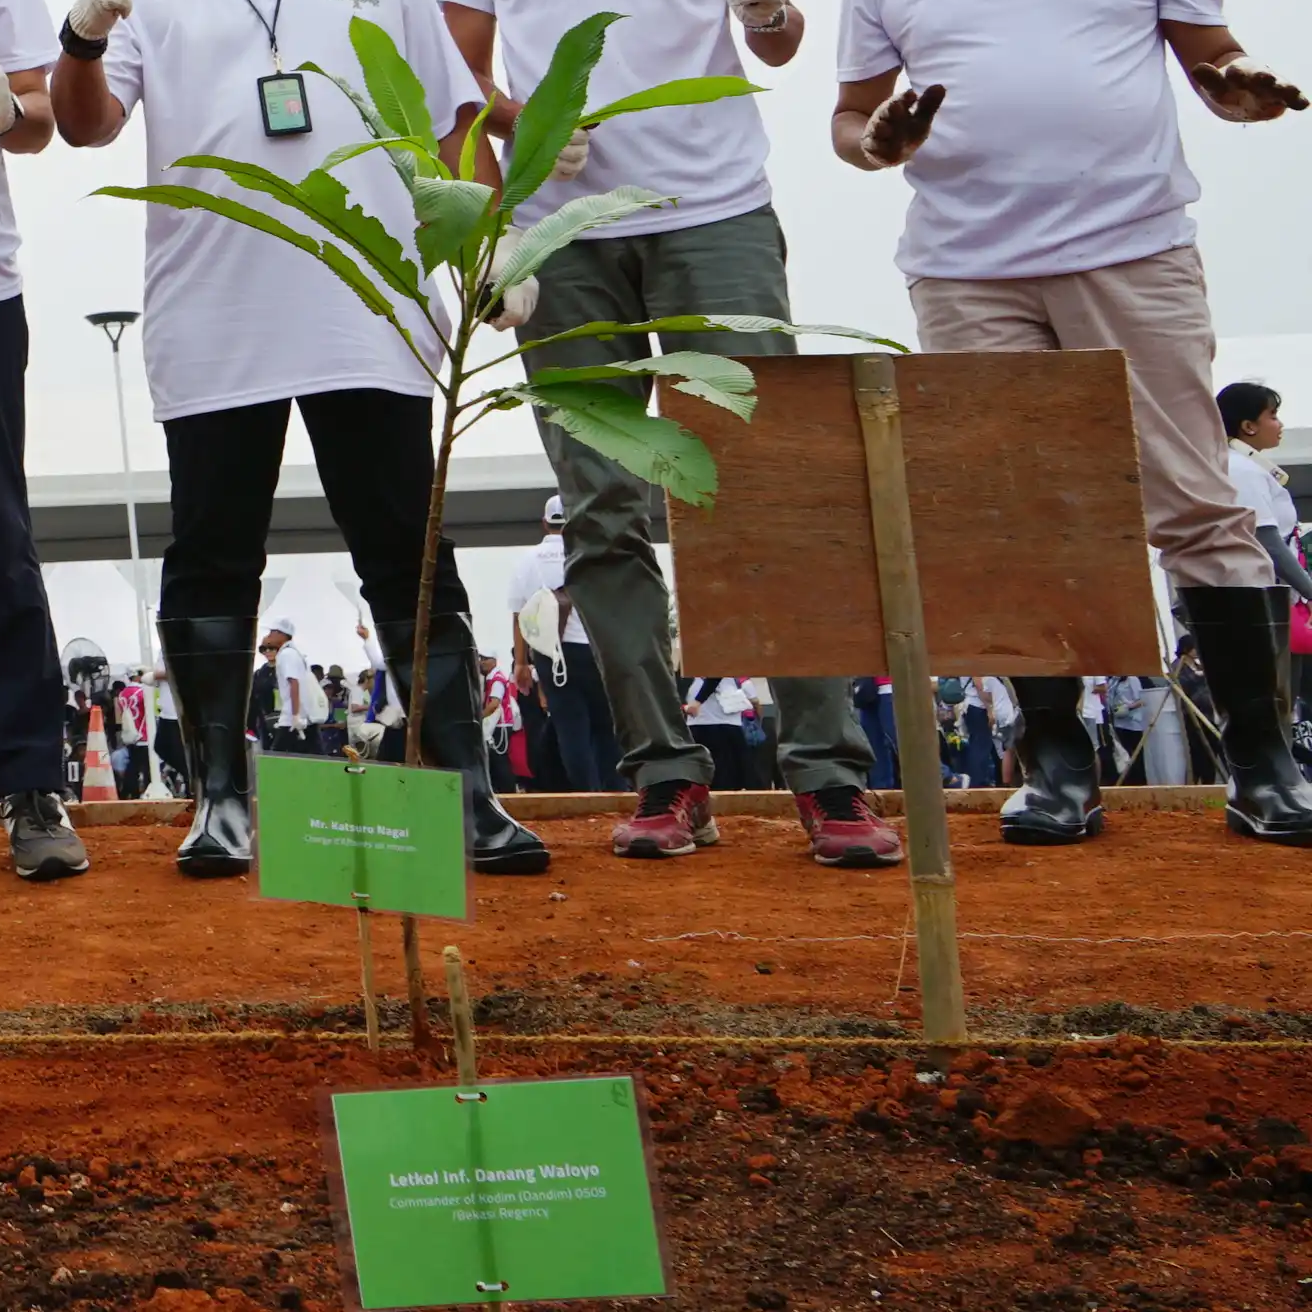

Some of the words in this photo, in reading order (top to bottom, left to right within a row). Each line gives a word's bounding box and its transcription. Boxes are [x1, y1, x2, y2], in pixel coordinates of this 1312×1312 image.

[310, 819, 329, 829] Mr.
[332, 822, 374, 834] Katsuro
[377, 825, 409, 839] Nagai
[390, 1170, 439, 1187] Letkol
[443, 1169, 471, 1184] Inf.
[475, 1167, 536, 1184] Danang
[538, 1163, 600, 1180] Waloyo
[389, 1193, 461, 1209] Commander
[463, 1193, 475, 1205] of
[499, 1207, 549, 1221] Regency
